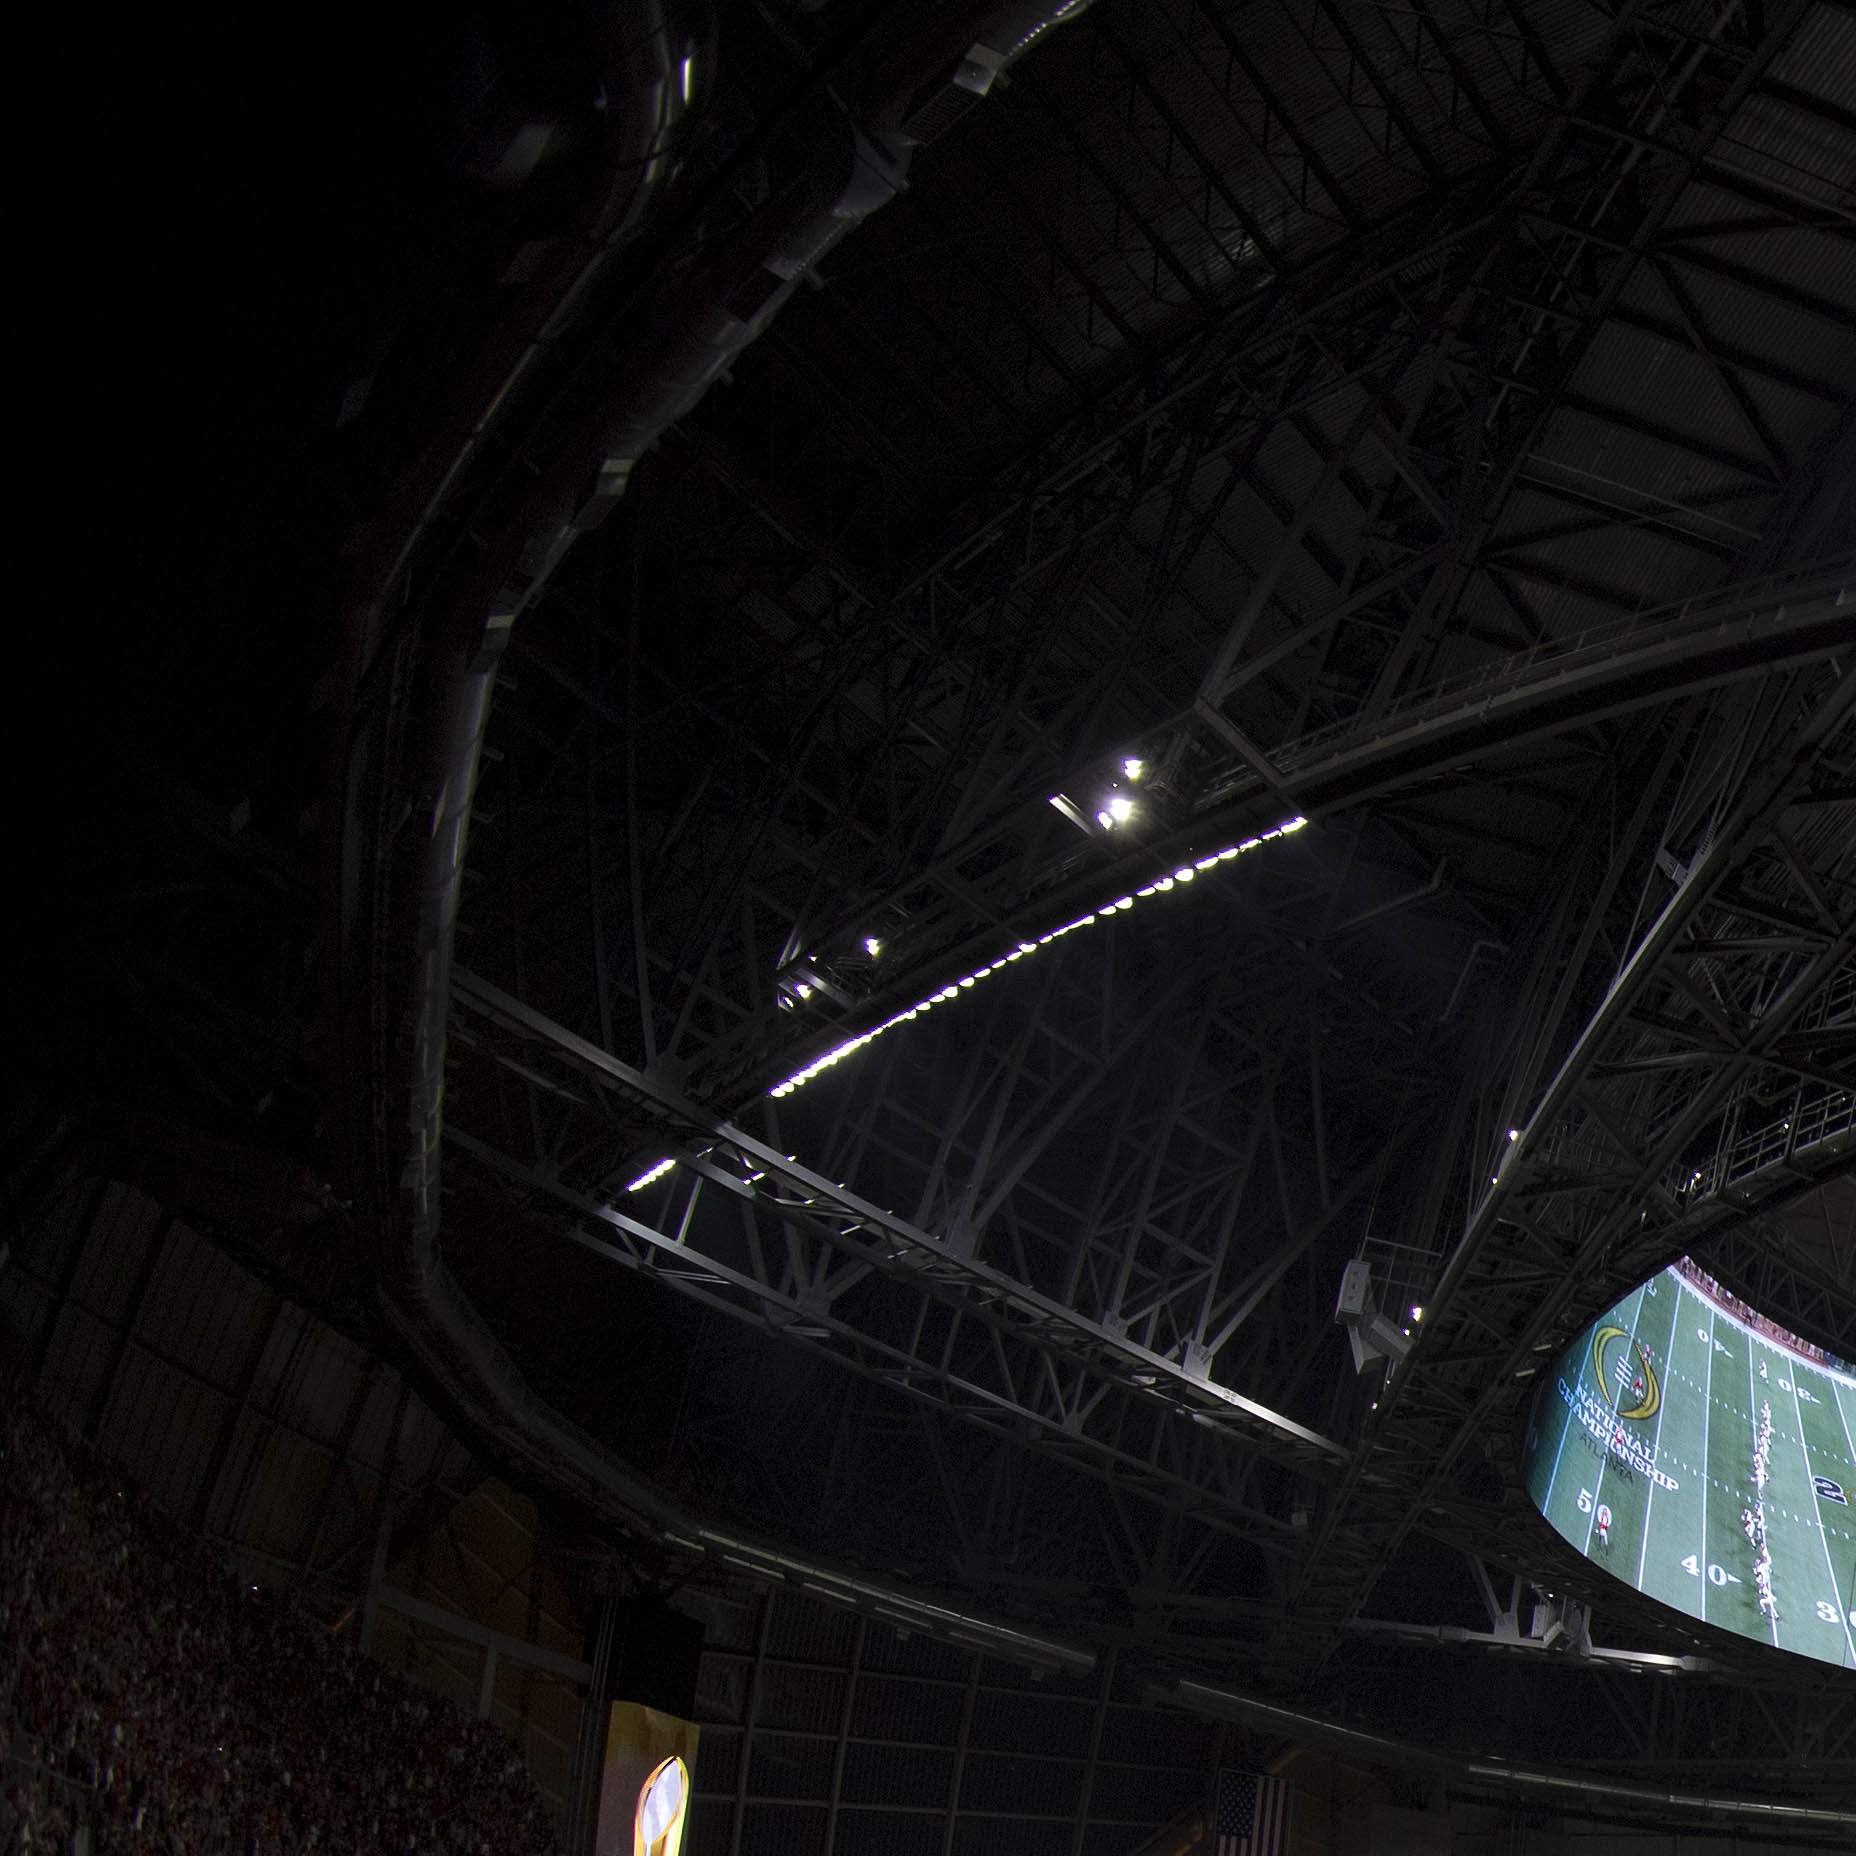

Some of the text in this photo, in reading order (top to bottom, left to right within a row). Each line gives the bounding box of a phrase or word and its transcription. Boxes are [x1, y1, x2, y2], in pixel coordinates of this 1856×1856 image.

[1557, 1376, 1679, 1491] CHAMPIONSHIP
[1575, 1384, 1658, 1461] NATIONAL
[1681, 1555, 1727, 1586] 40
